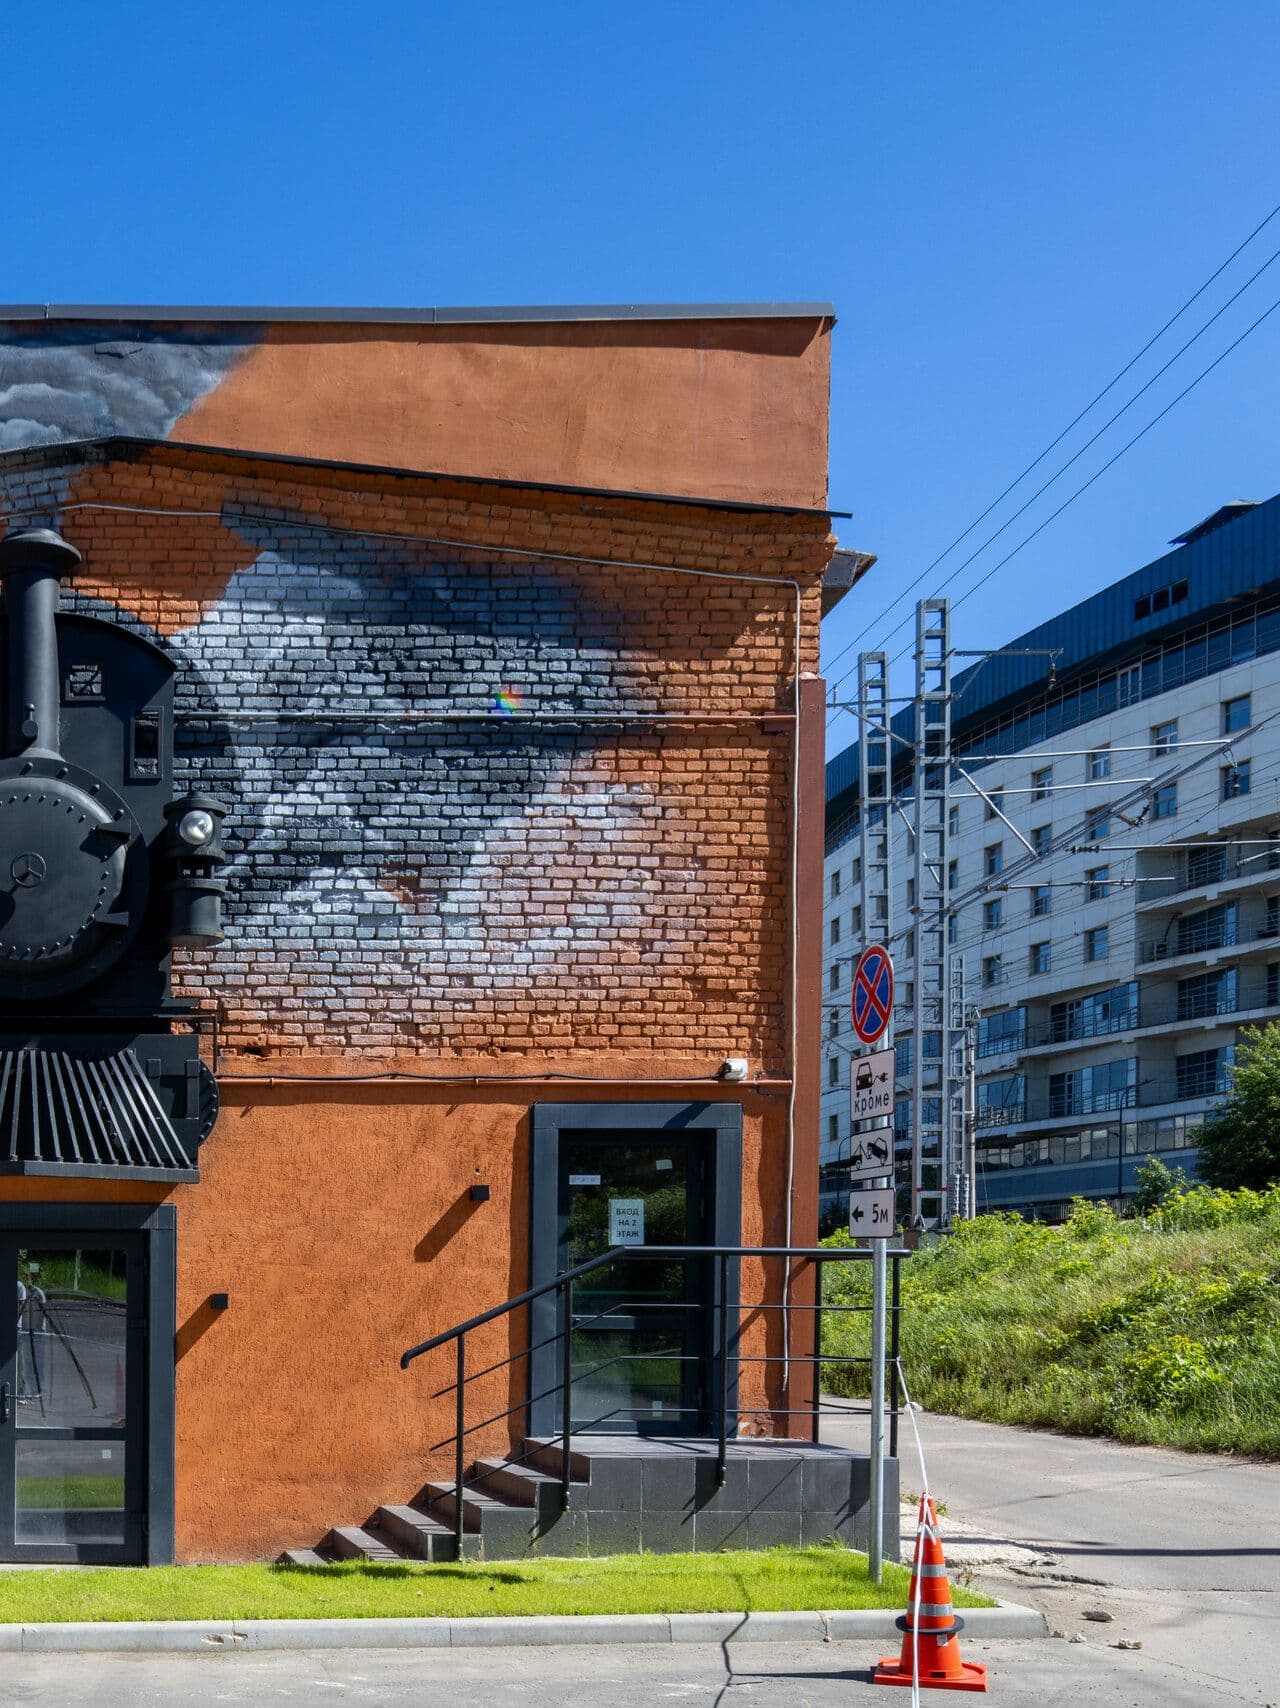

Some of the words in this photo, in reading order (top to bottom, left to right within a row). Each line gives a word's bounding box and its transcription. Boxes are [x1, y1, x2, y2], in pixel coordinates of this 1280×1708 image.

[855, 1093, 890, 1116] кроме
[616, 1208, 639, 1216] ВХОД
[872, 1203, 889, 1224] 5м
[616, 1230, 639, 1238] ЭТАЖ
